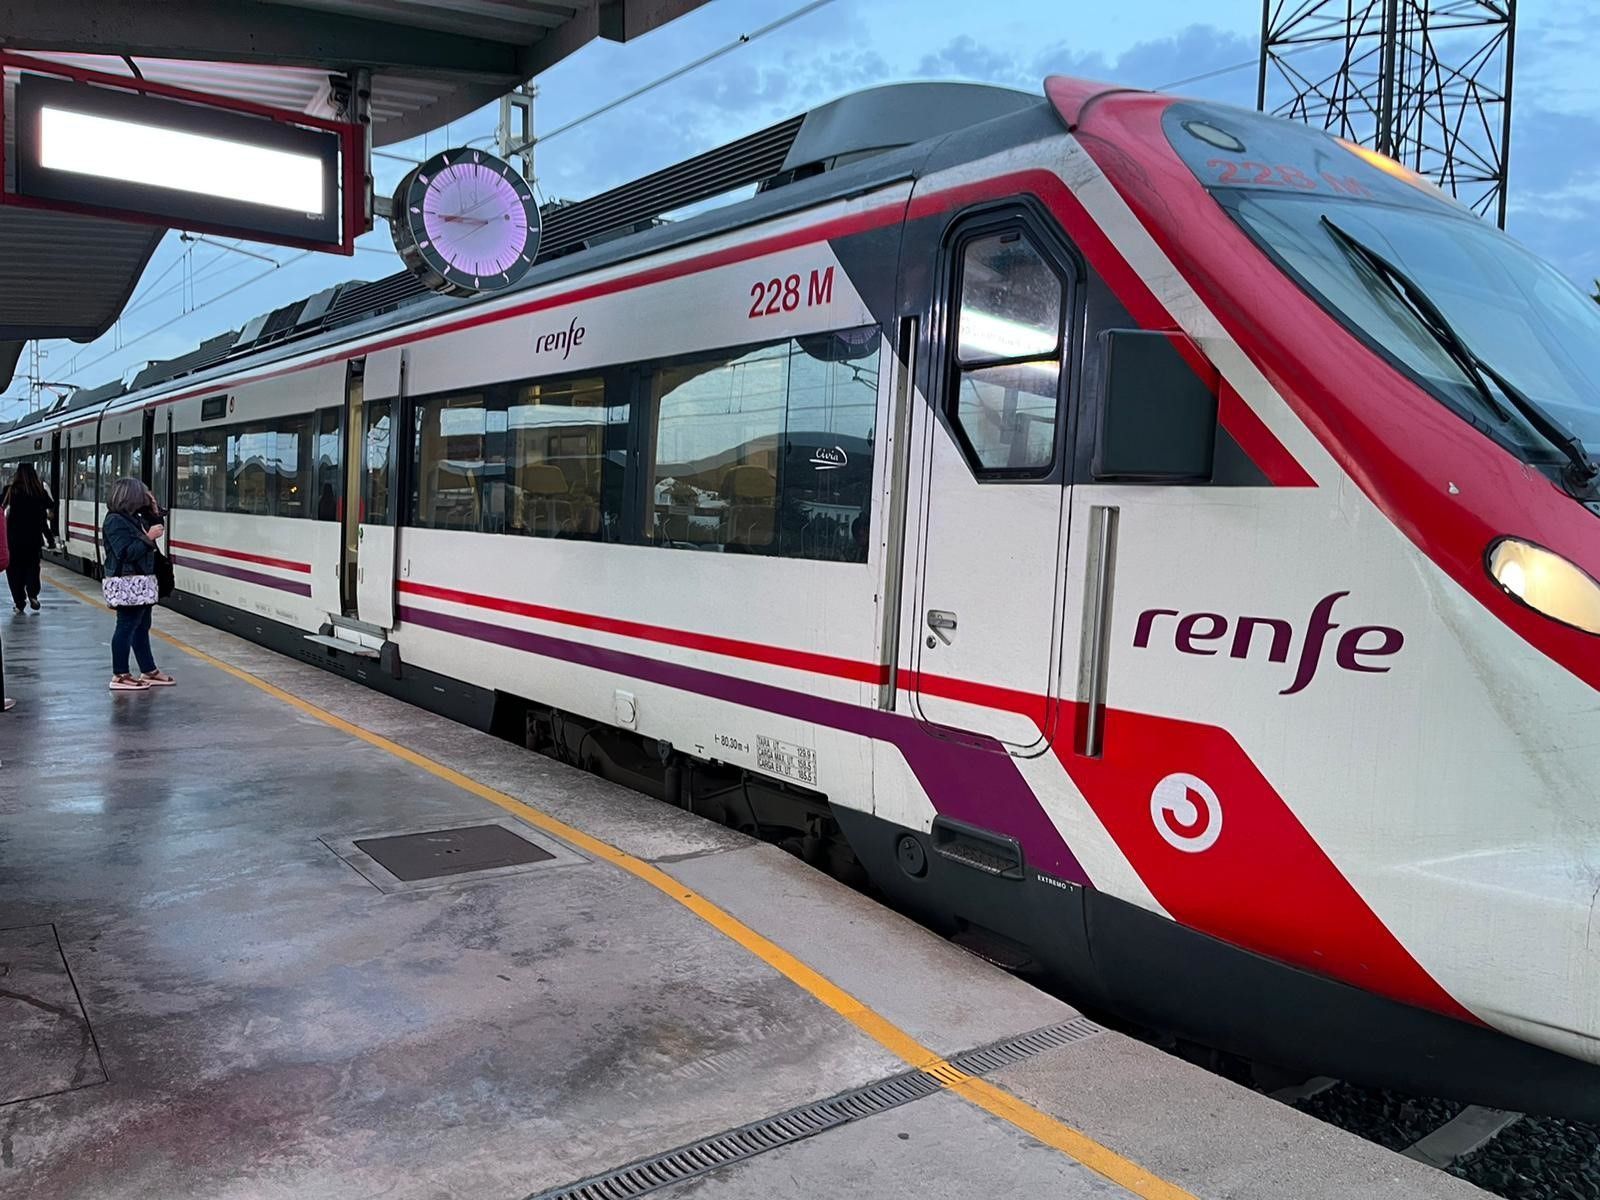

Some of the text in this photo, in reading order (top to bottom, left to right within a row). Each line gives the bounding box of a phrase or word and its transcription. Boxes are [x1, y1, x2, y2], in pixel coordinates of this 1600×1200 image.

[1206, 159, 1375, 198] 228 M
[748, 266, 834, 319] 228 M
[535, 316, 586, 360] renfe
[815, 447, 839, 461] Civia
[1132, 590, 1404, 695] renfe
[1037, 874, 1067, 890] EXTREMO
